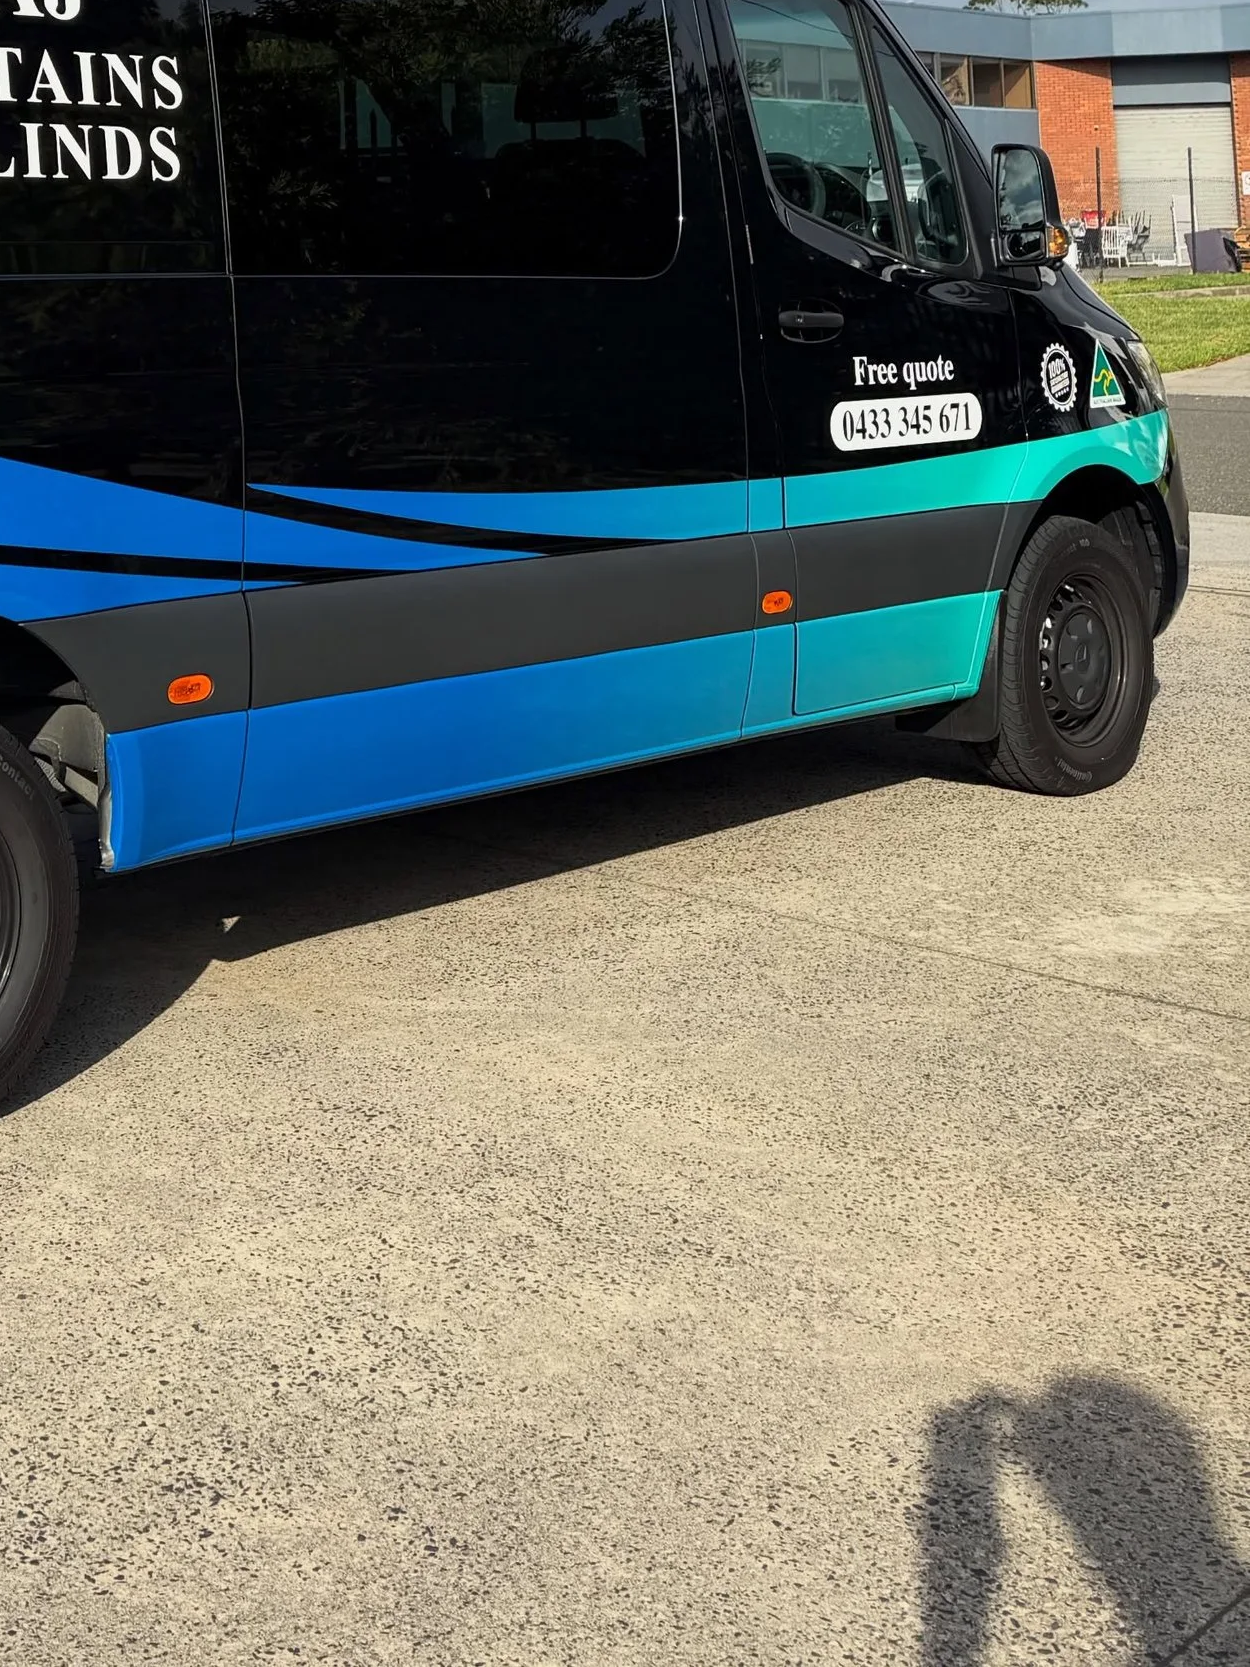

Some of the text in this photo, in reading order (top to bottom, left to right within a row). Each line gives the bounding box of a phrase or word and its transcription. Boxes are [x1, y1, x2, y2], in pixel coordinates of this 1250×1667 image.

[852, 354, 955, 390] Free quote
[842, 401, 971, 442] 0433 345 671
